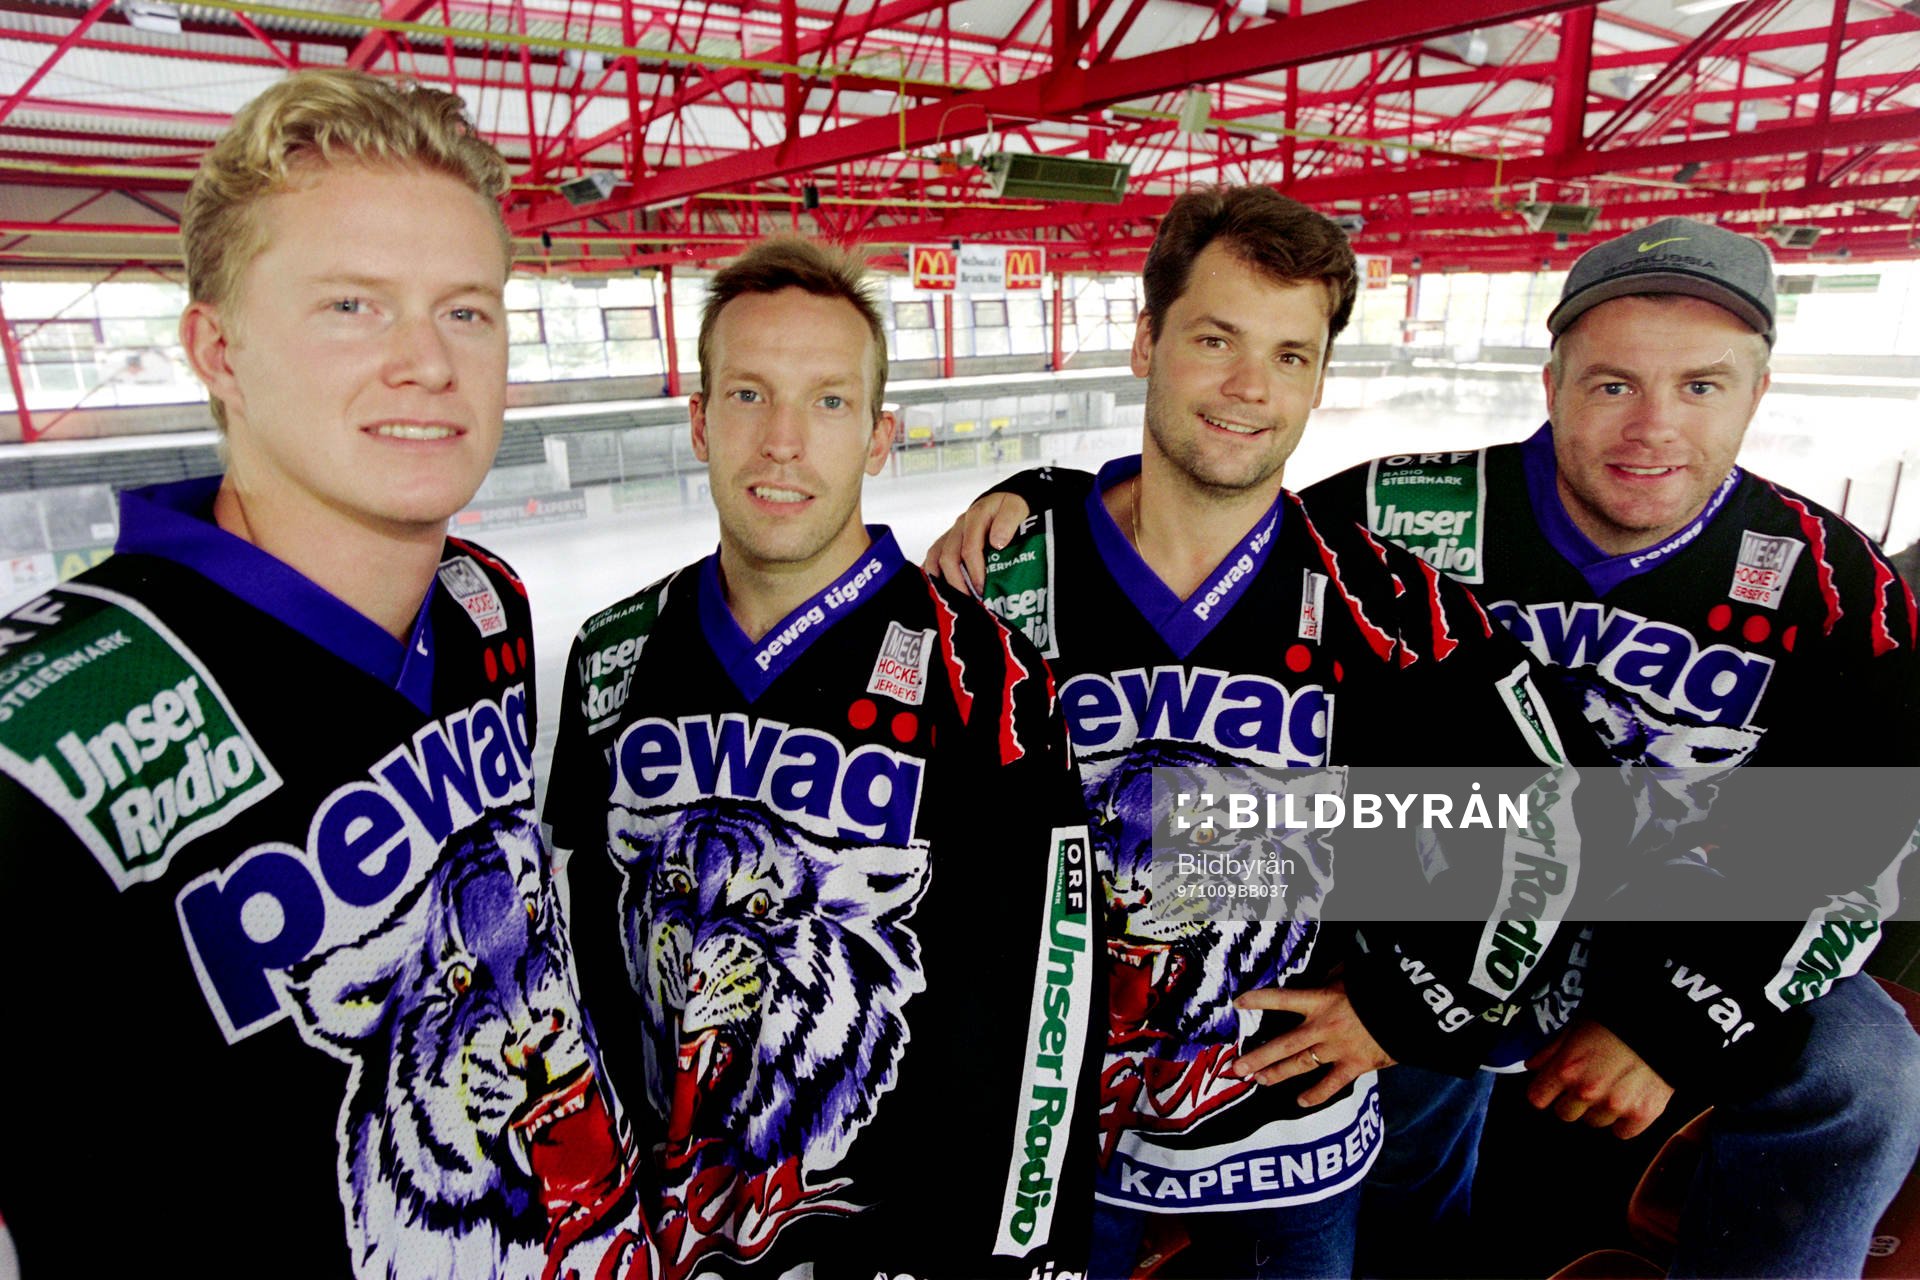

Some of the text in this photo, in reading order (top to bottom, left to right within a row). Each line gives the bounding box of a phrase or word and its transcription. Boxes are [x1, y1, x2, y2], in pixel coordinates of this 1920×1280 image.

[1381, 476, 1462, 486] STEIERMARK
[1383, 469, 1423, 477] RADIO
[1370, 505, 1473, 537] Unser
[1744, 536, 1789, 570] MEGA
[1193, 554, 1254, 621] pewag
[755, 558, 883, 671] pewag tigers
[0, 652, 46, 690] DIO
[878, 658, 921, 686] HOCKE
[888, 628, 920, 668] MEG
[874, 677, 917, 702] JERSEYS
[32, 675, 205, 816] Unser
[110, 733, 254, 861] Radio
[606, 715, 924, 845] ewag
[1067, 843, 1083, 909] ORF
[1485, 851, 1568, 992] Radio
[1009, 910, 1087, 1246] Unser Radio
